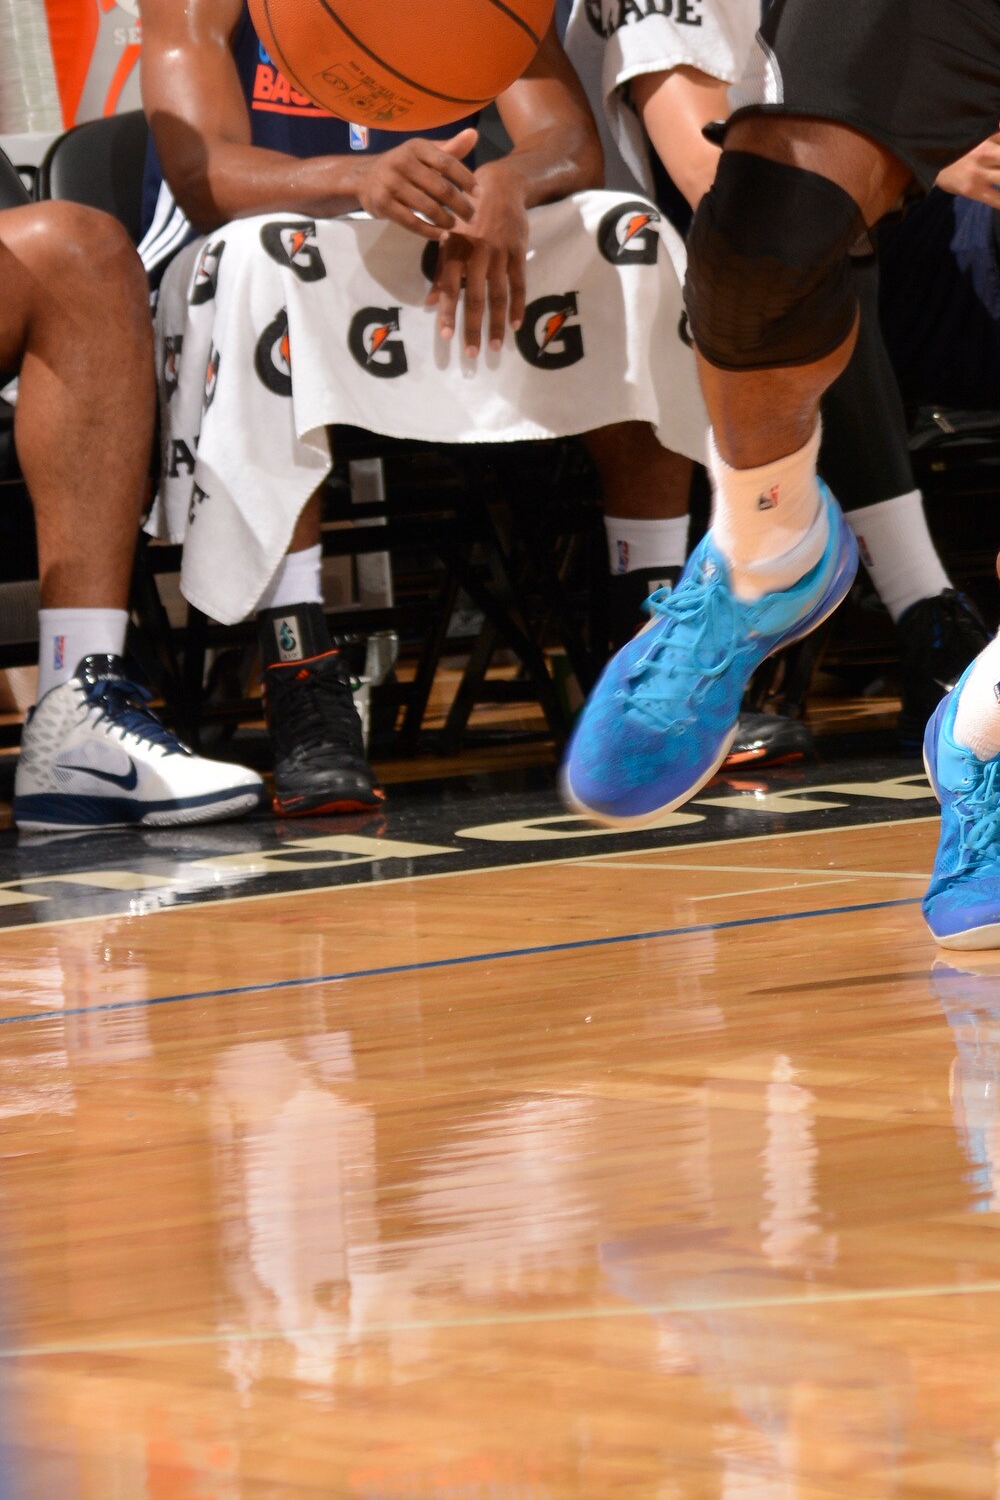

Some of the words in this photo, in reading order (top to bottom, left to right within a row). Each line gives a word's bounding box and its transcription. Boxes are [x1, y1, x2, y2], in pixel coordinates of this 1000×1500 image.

[260, 220, 327, 283] G
[597, 200, 661, 266] G
[348, 306, 409, 379] G
[515, 290, 585, 371] G
